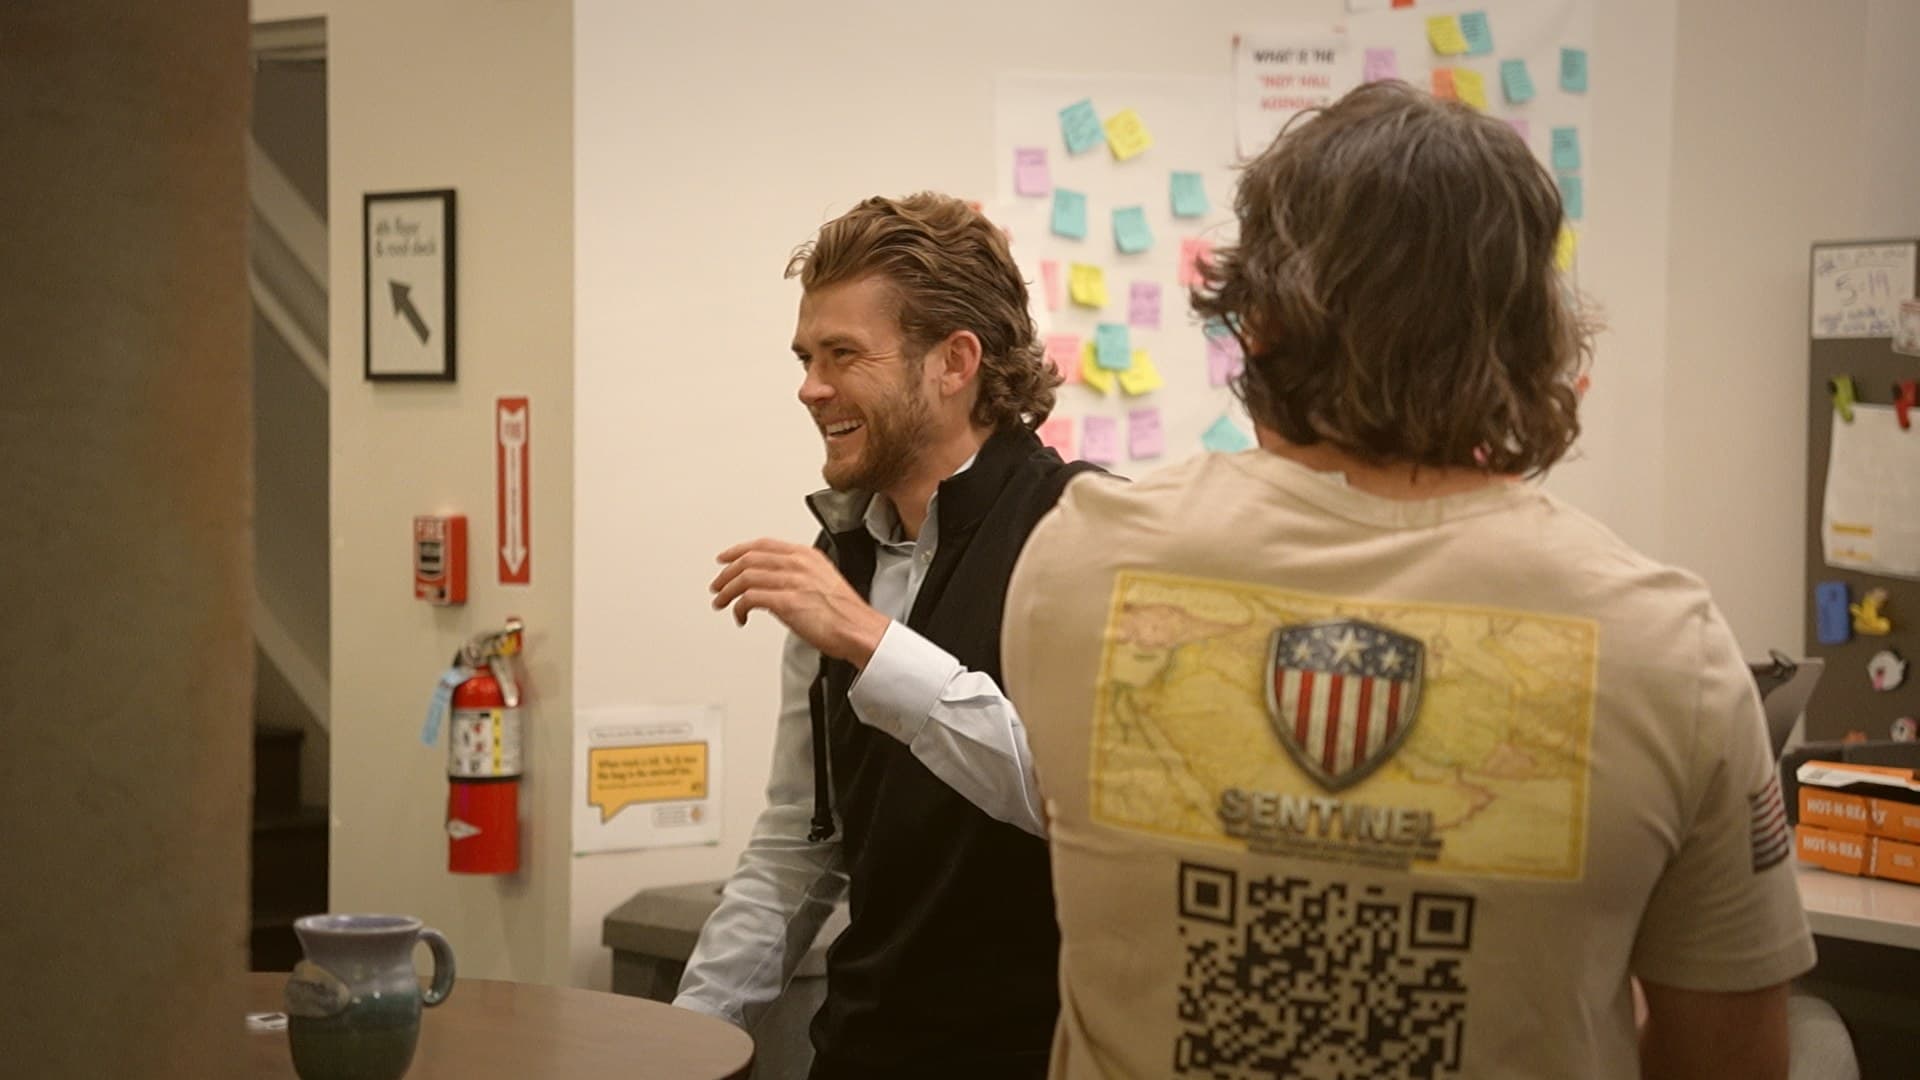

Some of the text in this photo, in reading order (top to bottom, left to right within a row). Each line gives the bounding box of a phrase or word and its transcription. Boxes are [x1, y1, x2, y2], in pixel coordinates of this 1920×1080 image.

[1254, 48, 1293, 63] WHAT
[1313, 48, 1335, 64] THE
[416, 519, 446, 539] FIRE
[1218, 788, 1440, 845] SENTINEL
